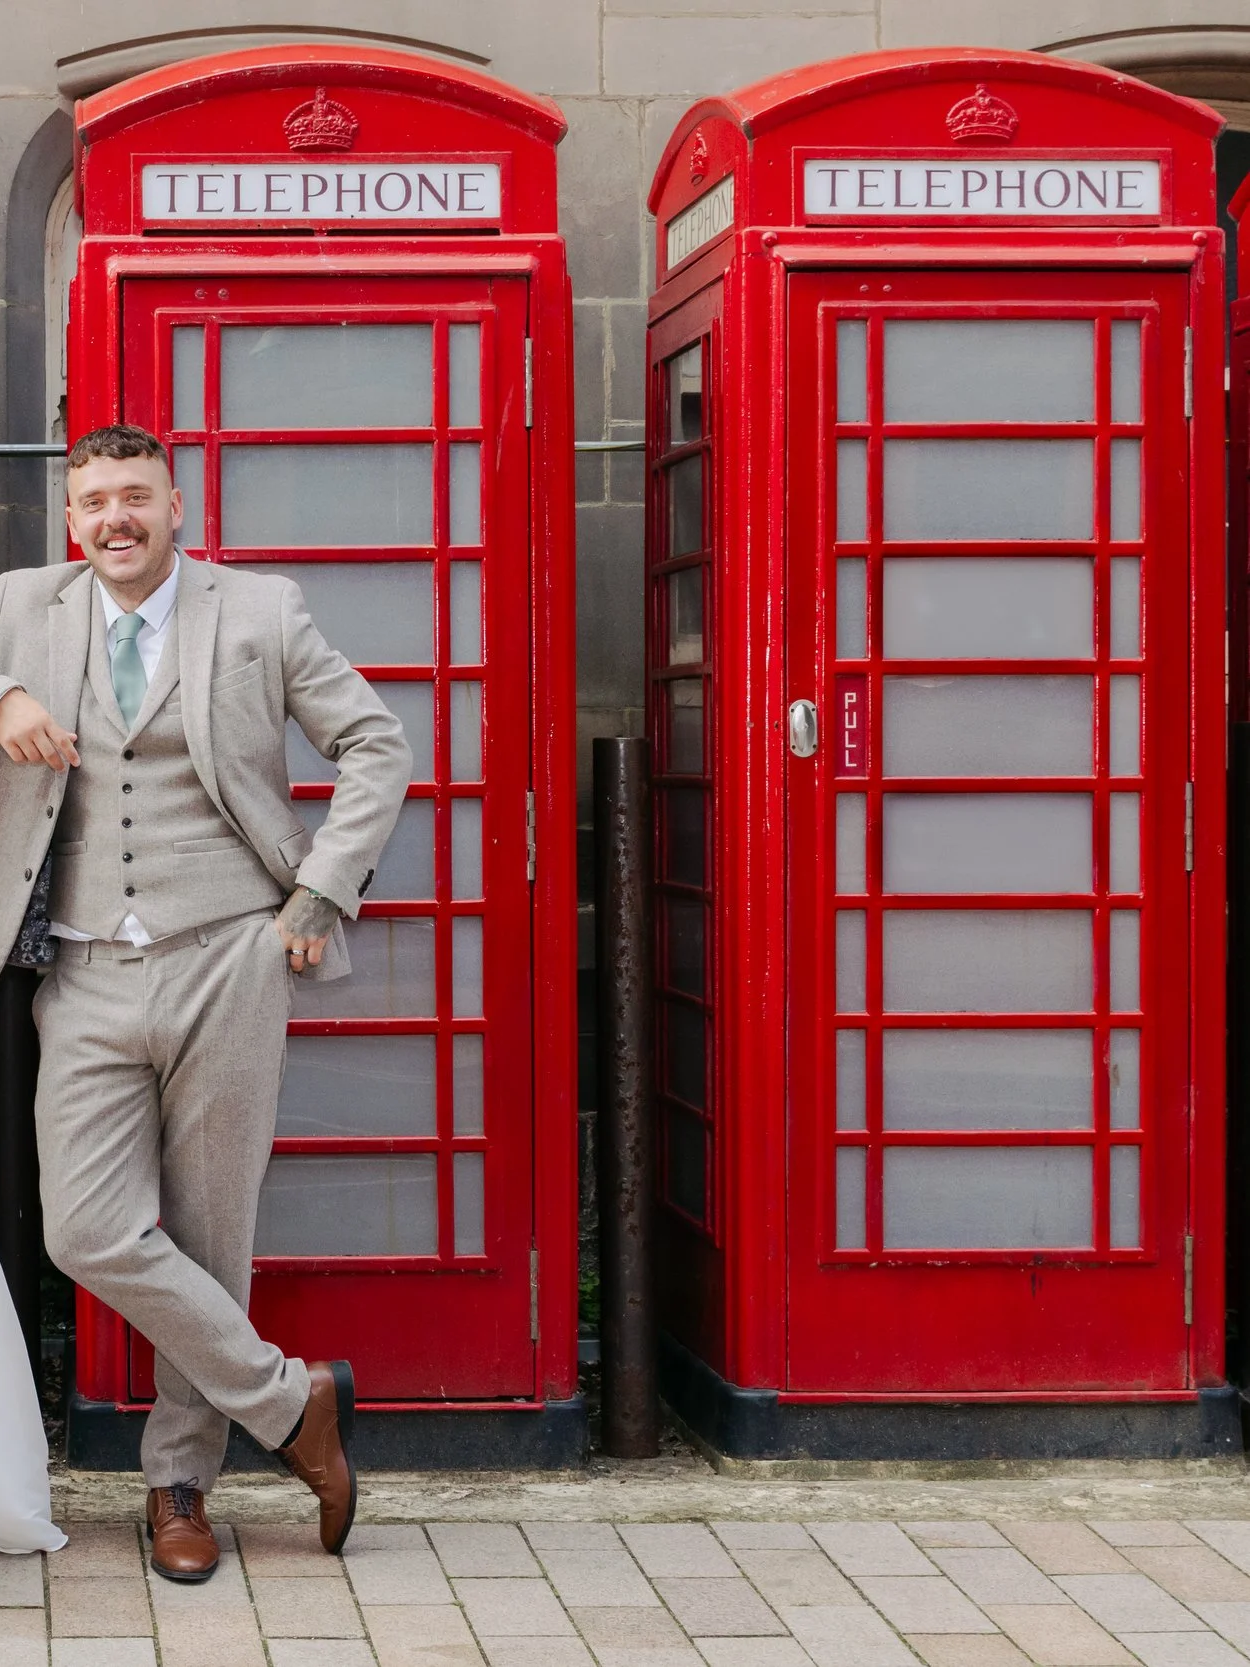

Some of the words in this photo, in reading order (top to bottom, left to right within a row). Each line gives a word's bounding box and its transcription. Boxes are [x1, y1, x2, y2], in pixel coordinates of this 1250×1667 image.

[156, 172, 486, 213] TELEPHONE
[817, 169, 1144, 209] TELEPHONE
[844, 692, 858, 767] PULL
